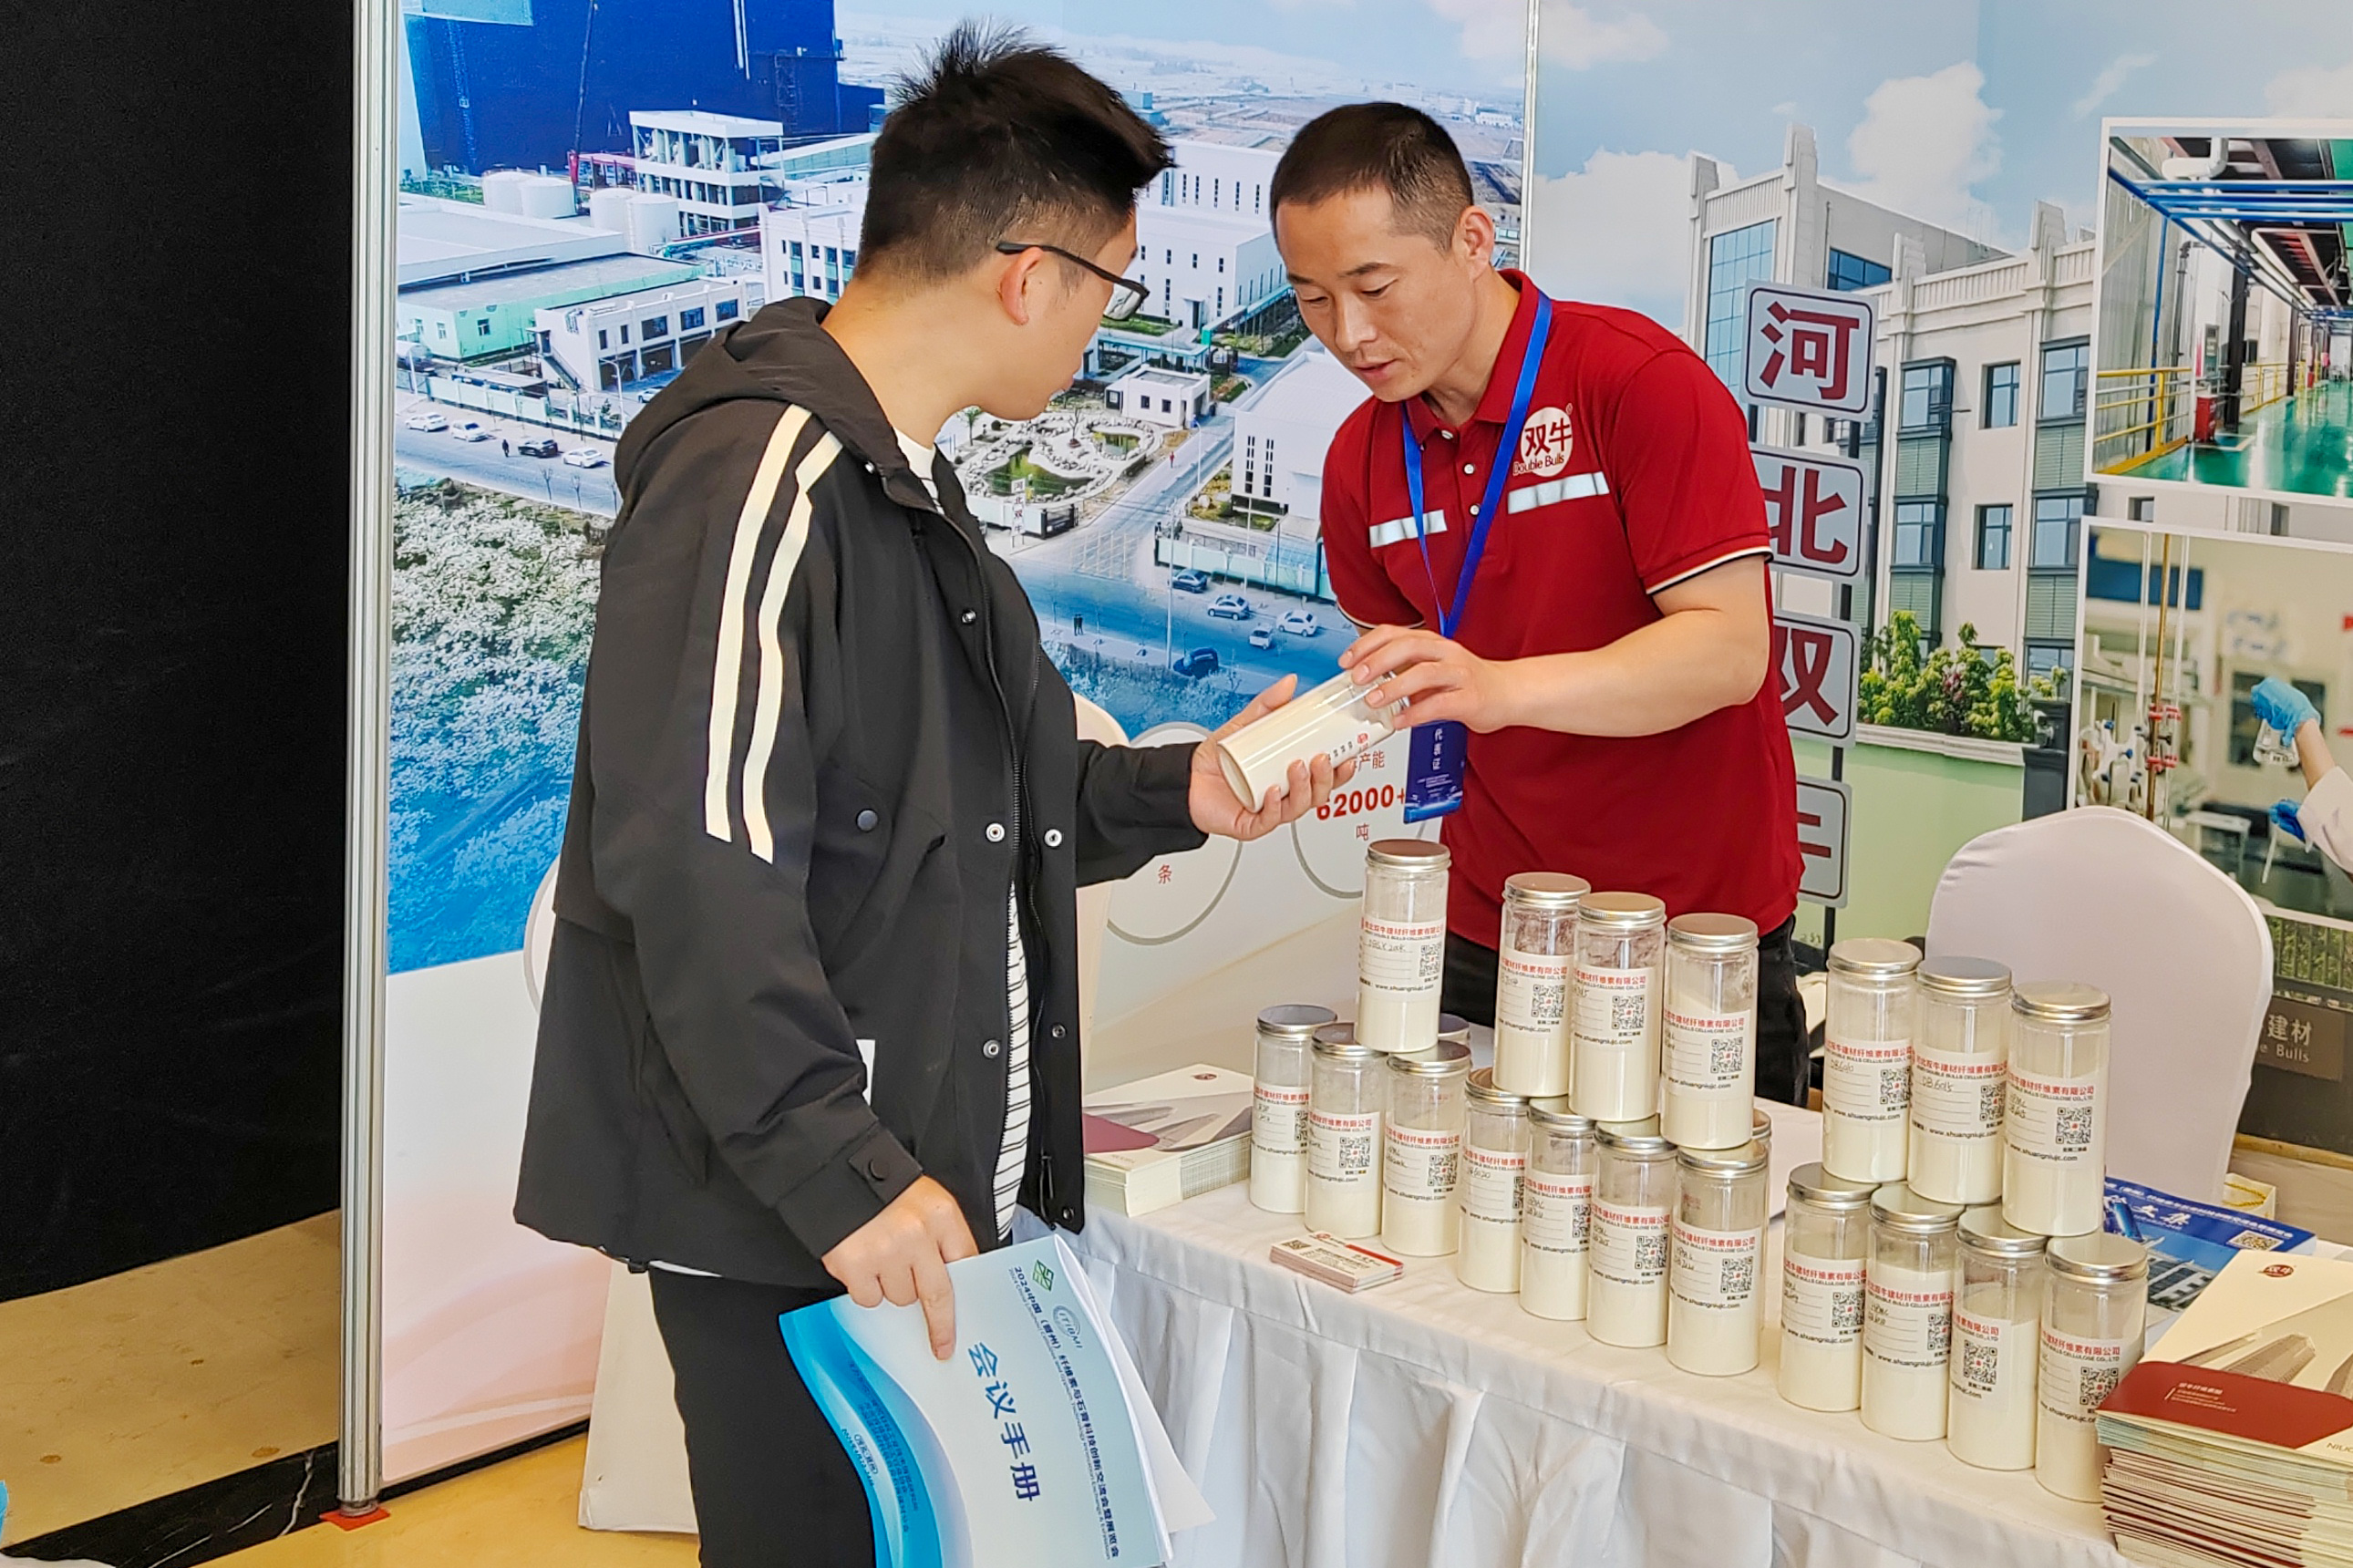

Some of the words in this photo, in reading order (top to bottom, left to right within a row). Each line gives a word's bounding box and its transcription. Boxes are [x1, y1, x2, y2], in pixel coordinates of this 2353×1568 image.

[1525, 418, 1572, 457] 双牛
[1513, 459, 1543, 475] Double
[1545, 453, 1564, 467] Bulls
[1355, 751, 1385, 772] 产能
[1356, 823, 1369, 841] 吨
[1158, 865, 1171, 884] 条
[1501, 956, 1567, 975] 建材纤维素有限公司
[1574, 968, 1646, 985] 牛建材纤维素有限公司
[2267, 1014, 2311, 1046] 建材
[2276, 1044, 2309, 1063] Bulls
[1310, 1111, 1372, 1127] 建材纤维素有限公司
[968, 1342, 1040, 1501] 会议手册
